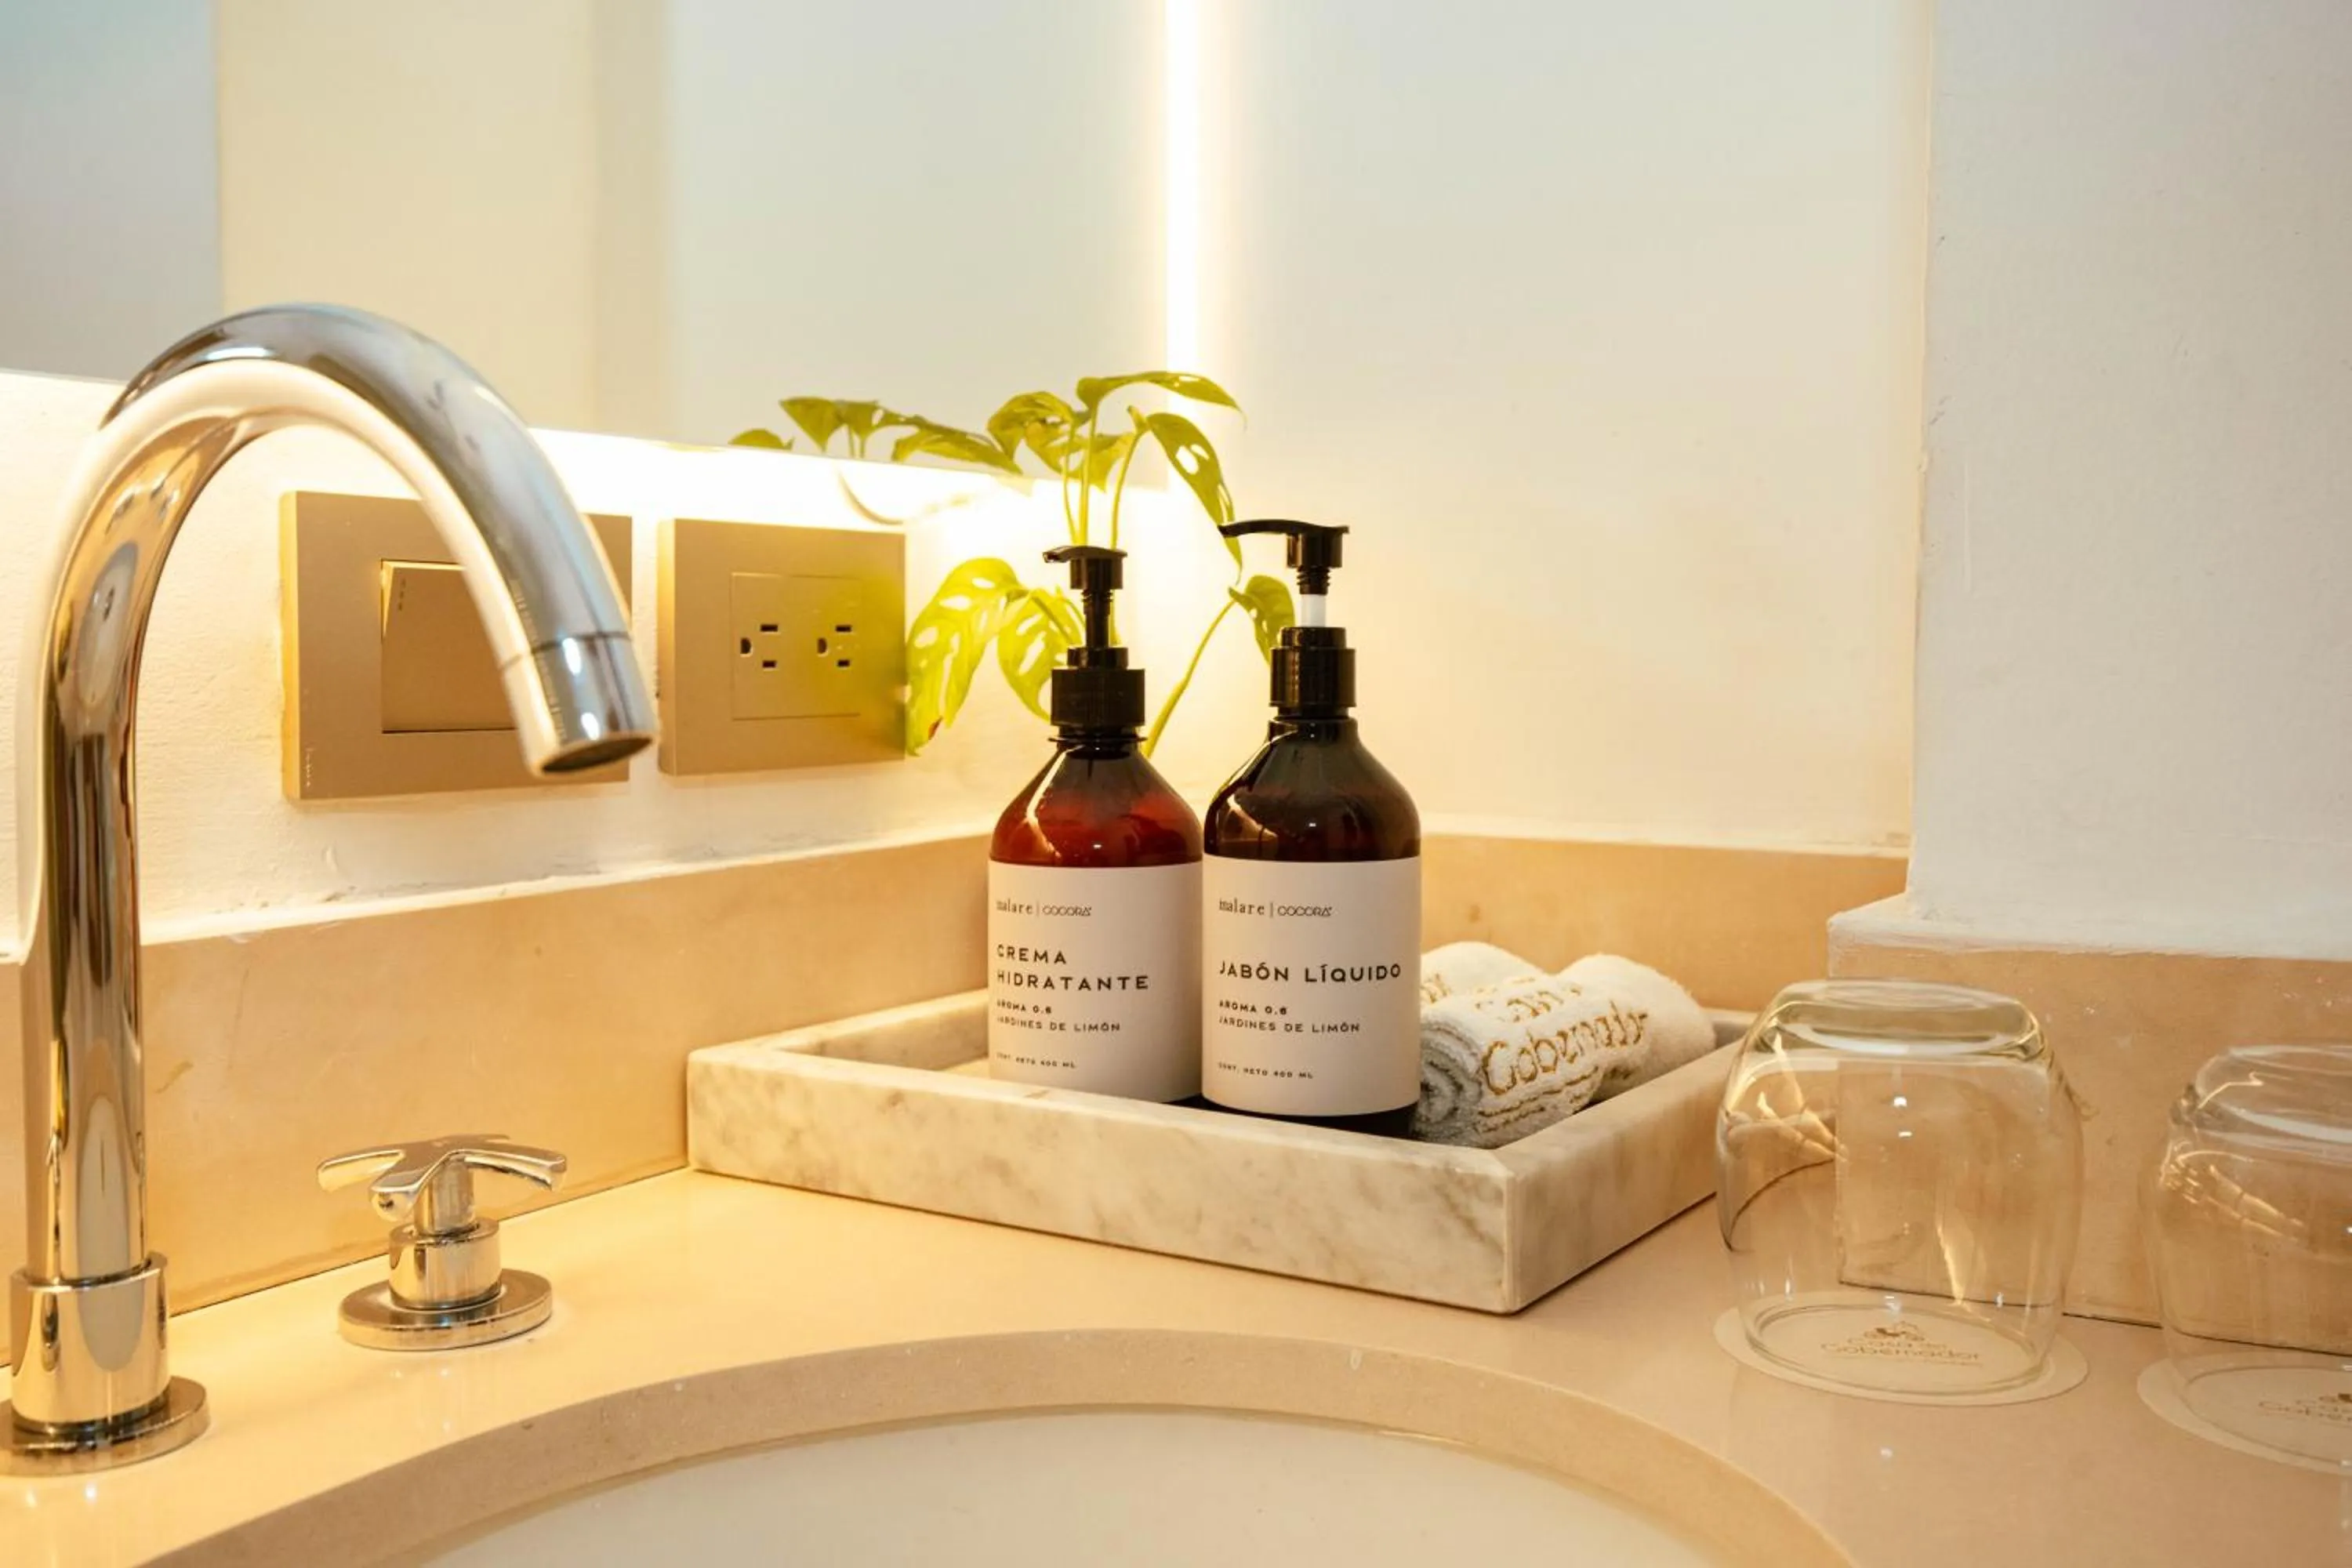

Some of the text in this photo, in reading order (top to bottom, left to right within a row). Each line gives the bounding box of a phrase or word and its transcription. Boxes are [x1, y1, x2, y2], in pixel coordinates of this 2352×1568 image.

[996, 945, 1067, 964] CREMA
[1219, 960, 1401, 982] JABÓN LÍQUIDO
[996, 970, 1149, 991] HIDRATANTE
[996, 999, 1026, 1012] AROMA
[1219, 999, 1257, 1013] AROMA
[997, 1015, 1120, 1032] JARDINES DE LIMÓN
[1219, 1018, 1360, 1033] JARDINES DE LIMÓN
